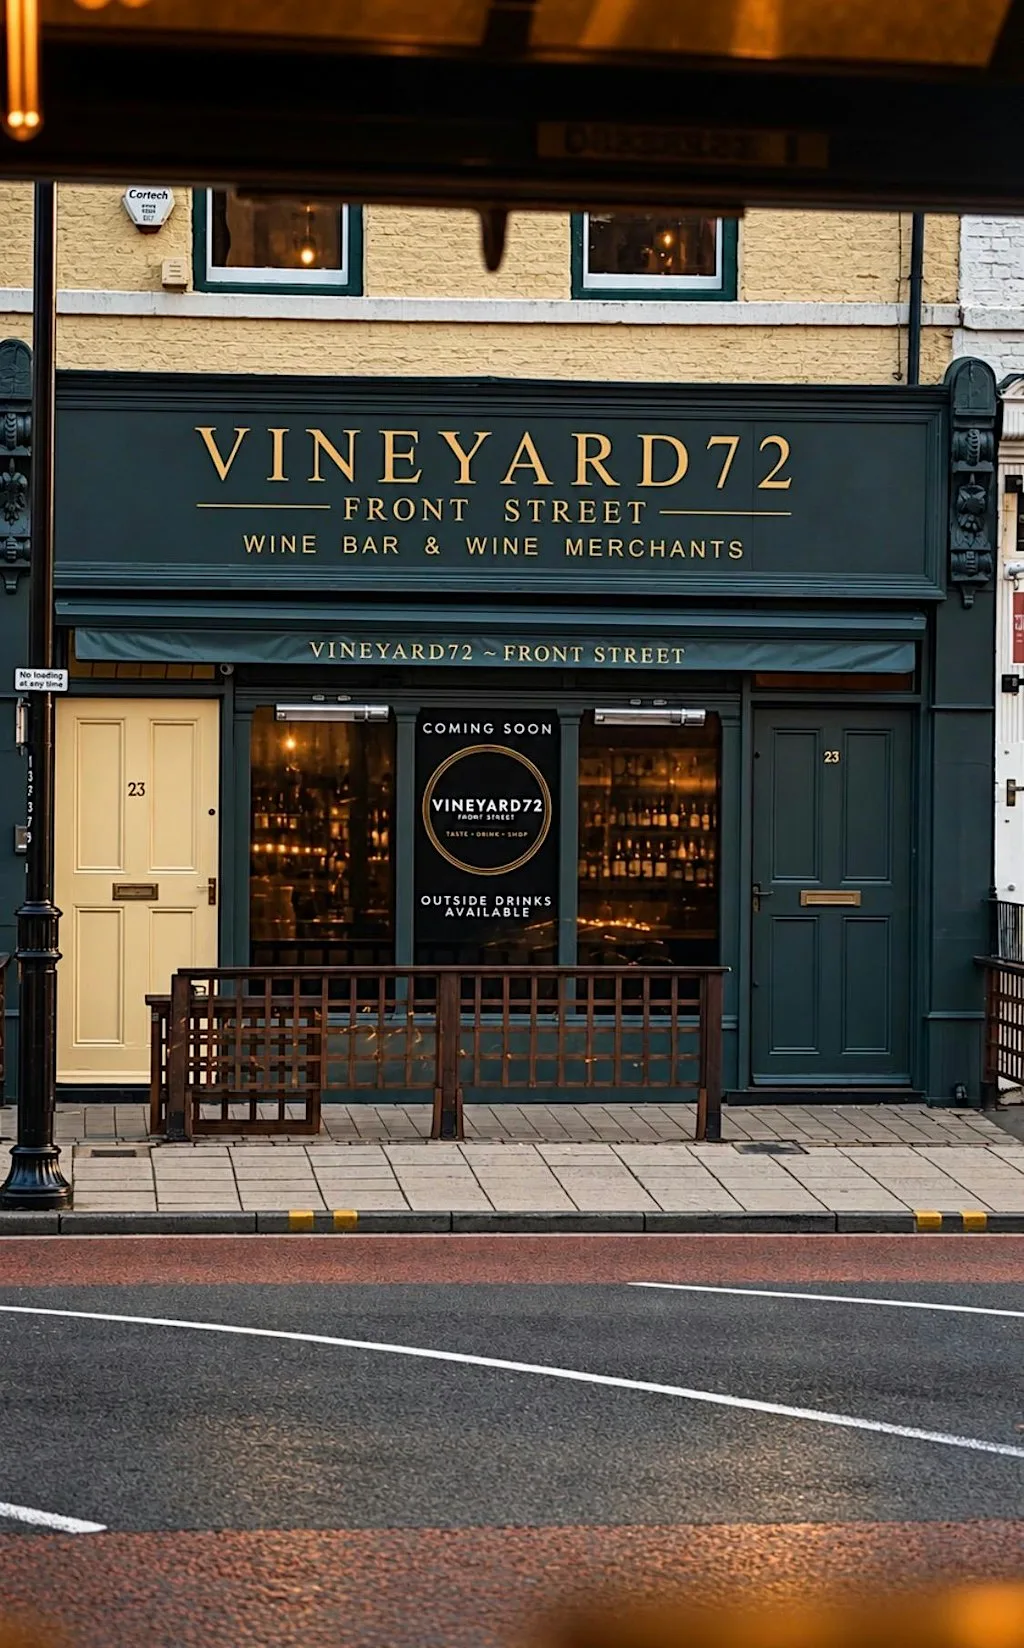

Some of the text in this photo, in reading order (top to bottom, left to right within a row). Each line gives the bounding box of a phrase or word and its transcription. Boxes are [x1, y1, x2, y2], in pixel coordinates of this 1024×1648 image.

[129, 190, 168, 199] Cortech
[194, 426, 792, 490] VINEYARD72
[343, 497, 646, 525] FRONT STREET
[243, 534, 744, 560] WINE BAR & WINE MERCHANTS
[309, 641, 474, 661] VINEYARD72
[503, 645, 584, 663] FRONT
[594, 647, 686, 665] STREET
[33, 672, 63, 680] loading
[422, 723, 552, 735] COMING SOON
[824, 751, 839, 763] 23
[128, 782, 145, 796] 23
[432, 798, 543, 813] VINEYARD72
[420, 896, 552, 907] OUTSIDE DRINKS
[445, 907, 530, 918] AVAILABLE
